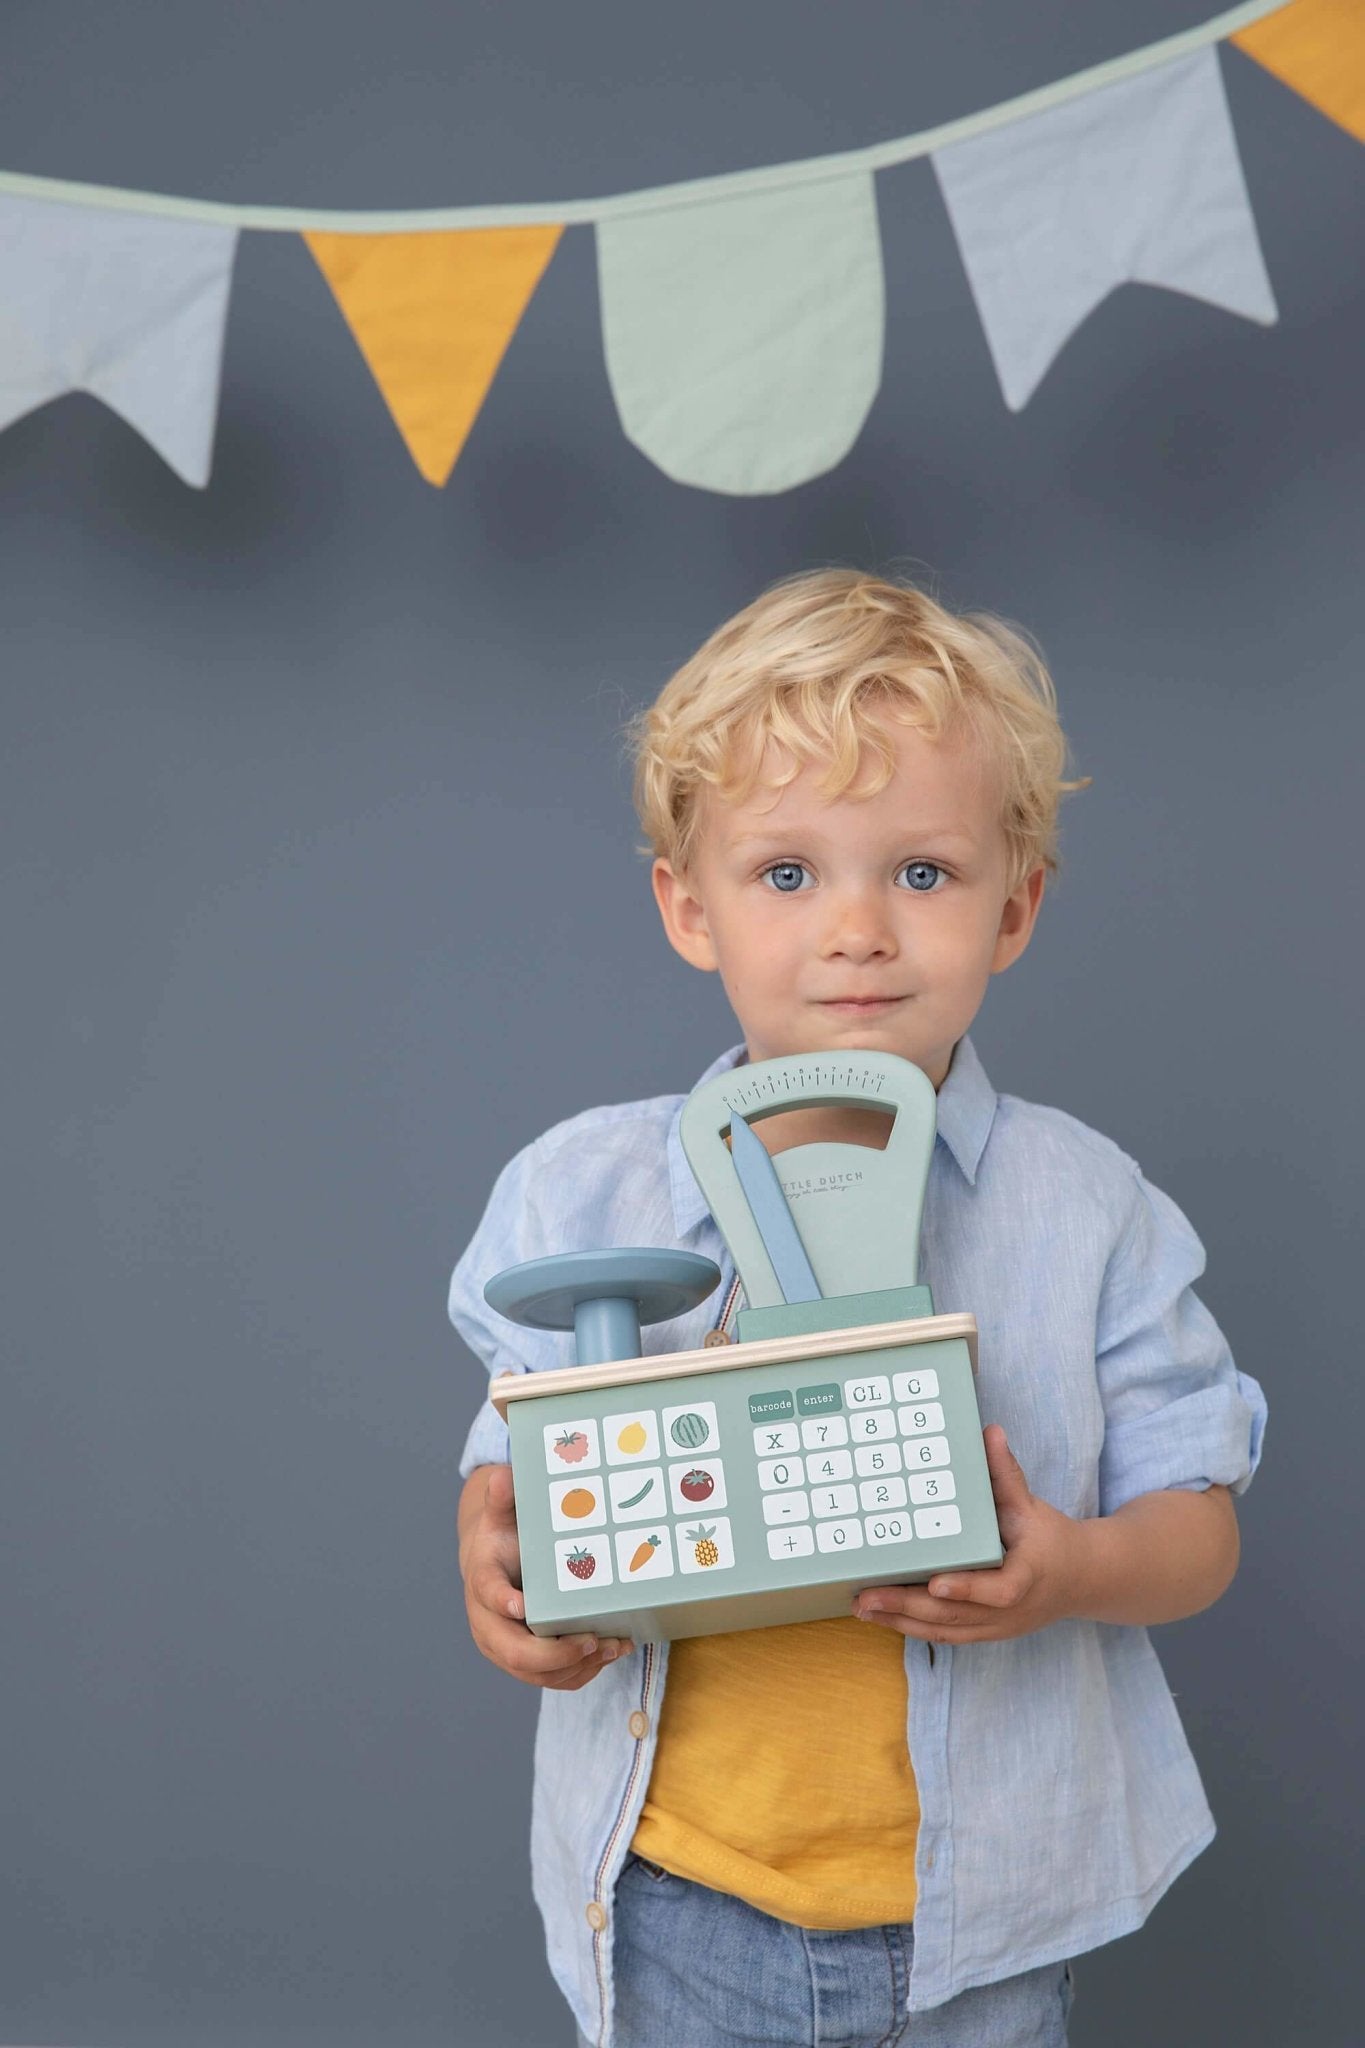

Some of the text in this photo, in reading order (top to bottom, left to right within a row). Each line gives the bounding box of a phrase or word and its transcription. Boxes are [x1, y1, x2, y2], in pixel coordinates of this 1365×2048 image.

[782, 1172, 863, 1191] TTLE DUTCH
[750, 1379, 920, 1414] barcode enter CL C
[817, 1426, 827, 1441] 7
[866, 1419, 877, 1434] 8
[914, 1412, 926, 1427] 9
[822, 1461, 834, 1475] 4
[873, 1453, 884, 1469] 5
[920, 1447, 931, 1462] 6
[828, 1494, 838, 1509] 1
[877, 1486, 889, 1502] 2
[926, 1480, 938, 1496] 3
[784, 1536, 797, 1551] +
[834, 1529, 845, 1544] 0
[874, 1521, 901, 1538] 00
